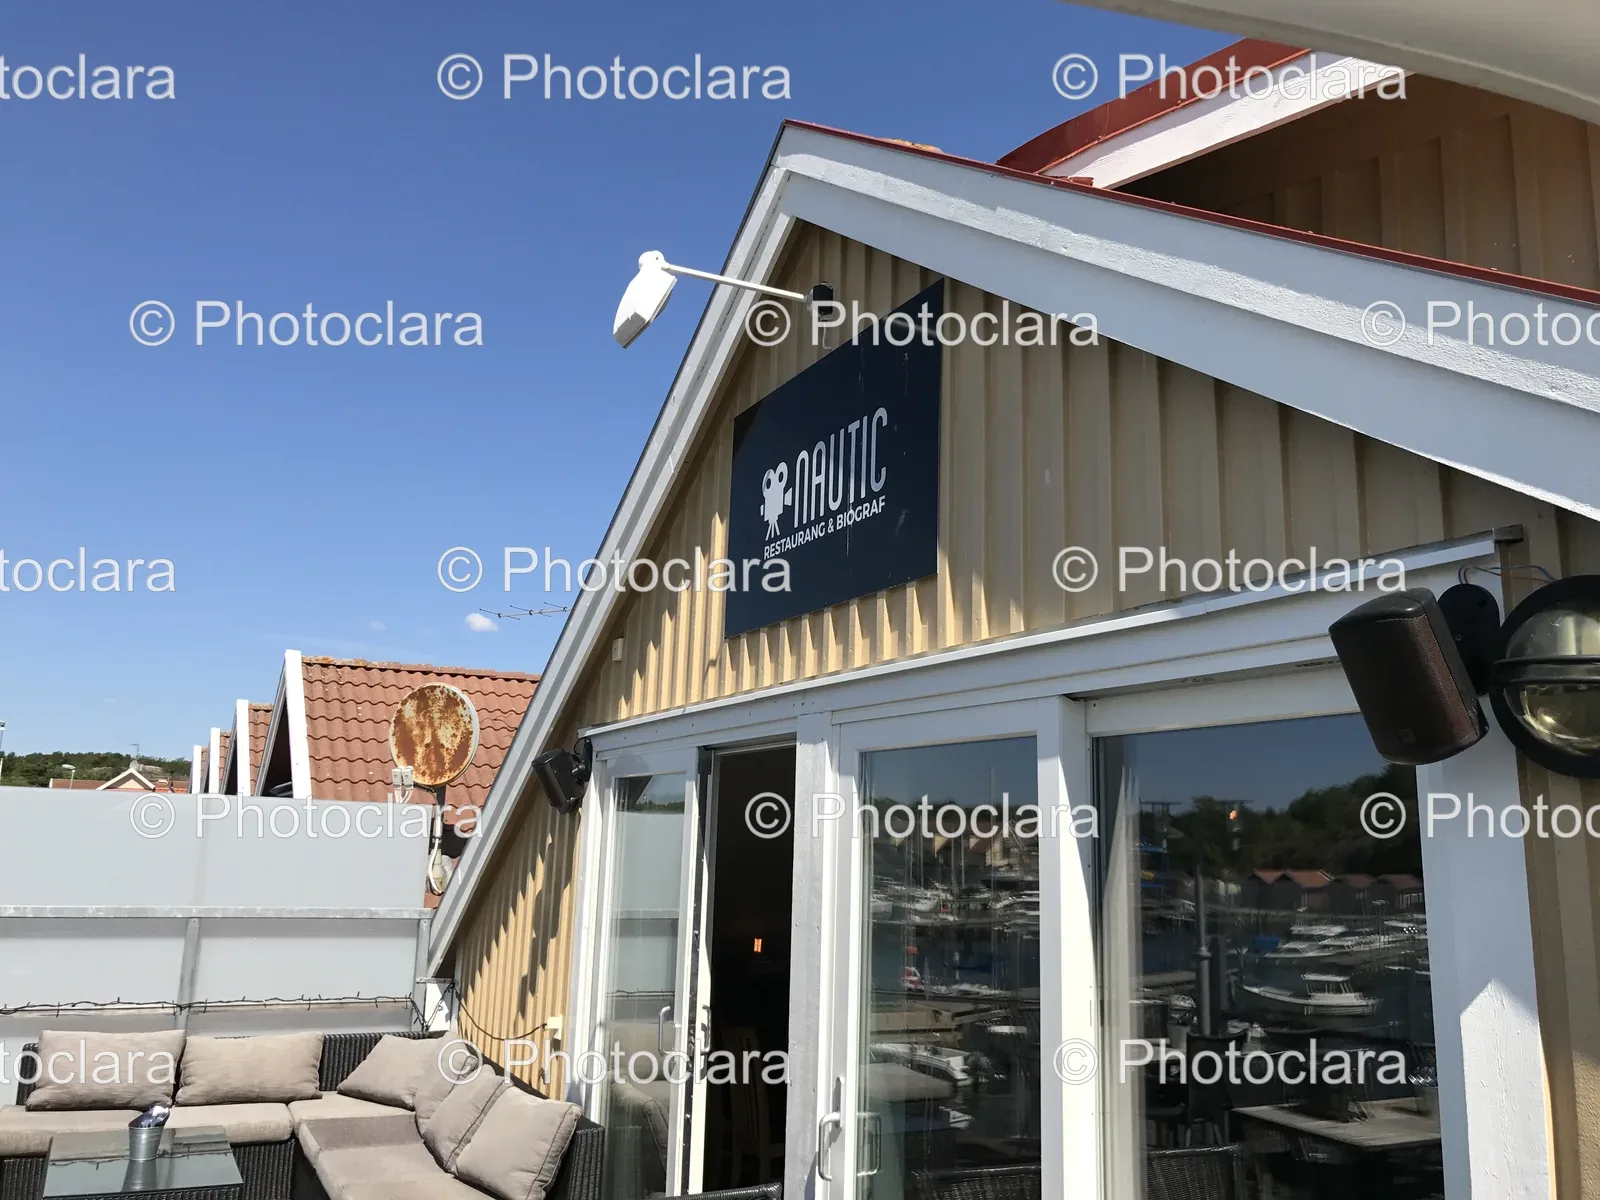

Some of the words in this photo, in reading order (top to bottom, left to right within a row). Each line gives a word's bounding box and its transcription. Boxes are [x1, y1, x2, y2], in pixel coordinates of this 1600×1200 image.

[763, 520, 826, 560] RESTAURANG
[827, 517, 835, 534] &
[836, 495, 886, 530] BIOGRAF
